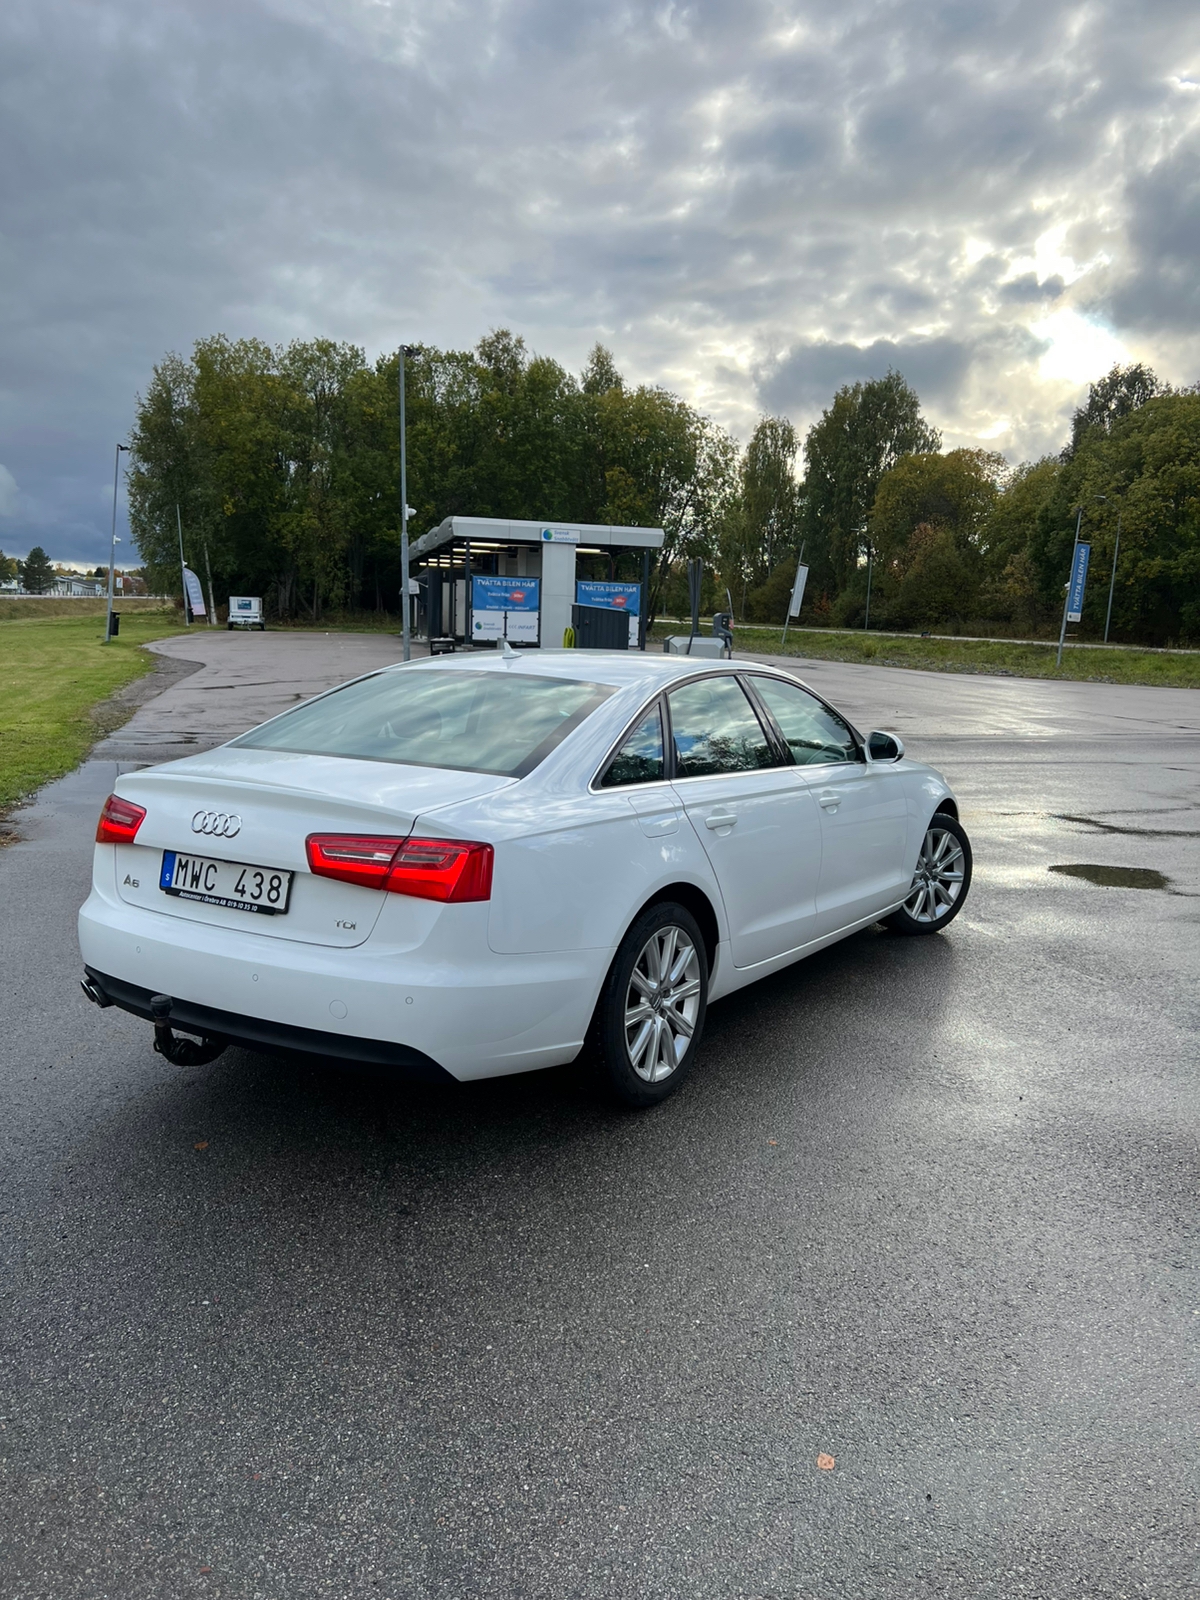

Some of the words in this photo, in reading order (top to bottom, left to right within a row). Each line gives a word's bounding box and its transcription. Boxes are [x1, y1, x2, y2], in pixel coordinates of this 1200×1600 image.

[1079, 548, 1087, 564] HÄR
[1077, 563, 1085, 584] BILEN
[477, 579, 502, 587] TVÄTTA
[502, 580, 521, 588] BILEN
[581, 584, 605, 592] TVÄTTA
[1073, 585, 1082, 610] TVÄTTA
[123, 873, 140, 888] A6
[174, 858, 218, 891] MWC
[233, 869, 282, 903] 438
[179, 891, 203, 901] Autocenter
[204, 895, 220, 905] Örebro
[219, 898, 227, 906] AB
[243, 903, 251, 911] 35
[334, 919, 357, 930] TDI
